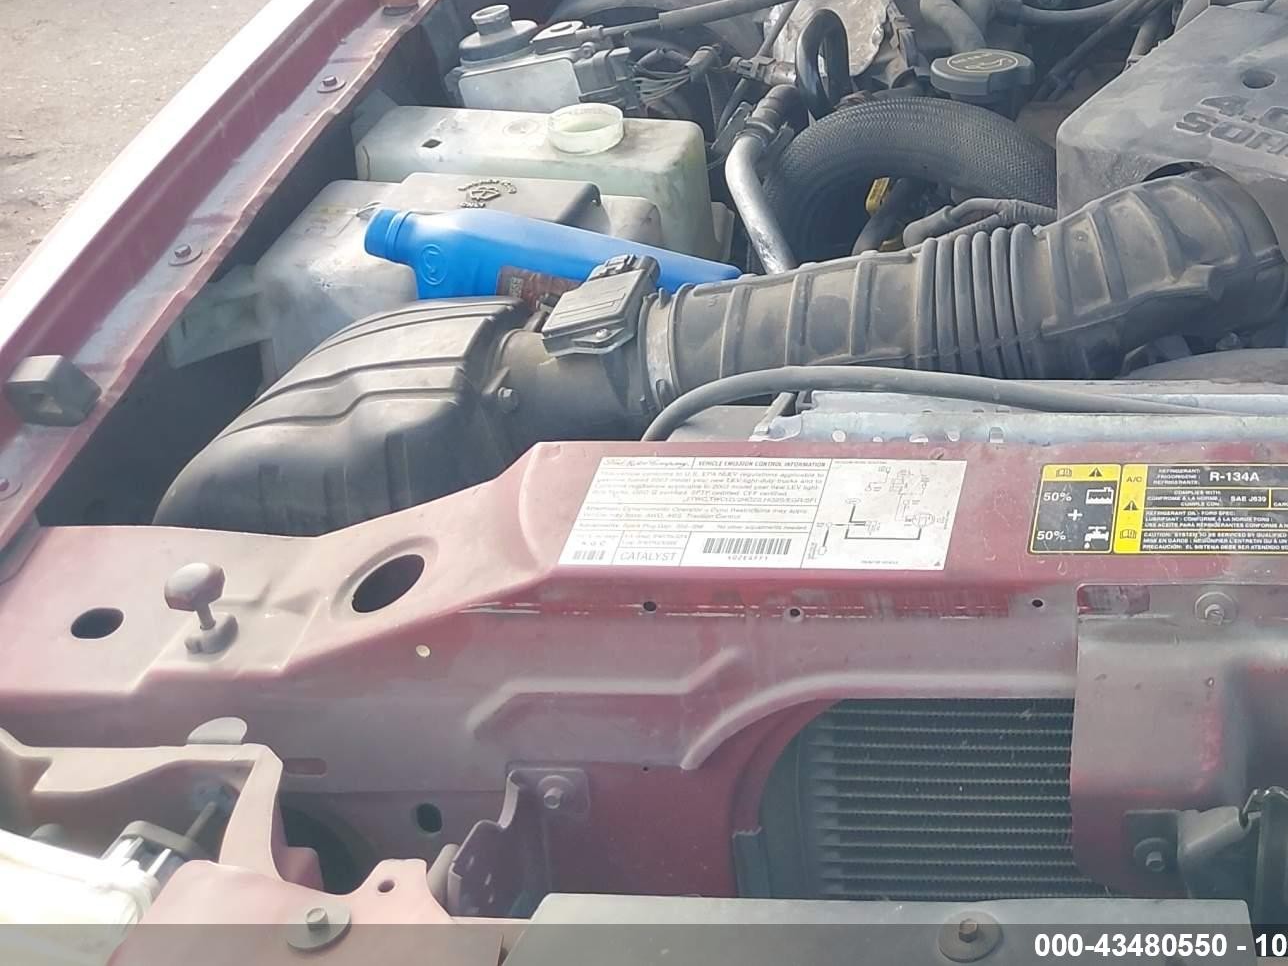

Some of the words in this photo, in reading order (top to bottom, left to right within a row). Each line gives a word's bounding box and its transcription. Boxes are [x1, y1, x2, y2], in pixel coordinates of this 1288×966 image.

[1209, 471, 1260, 482] R-134A
[1043, 492, 1072, 502] 50%
[1036, 530, 1066, 540] 50%
[619, 552, 678, 561] CATALYST
